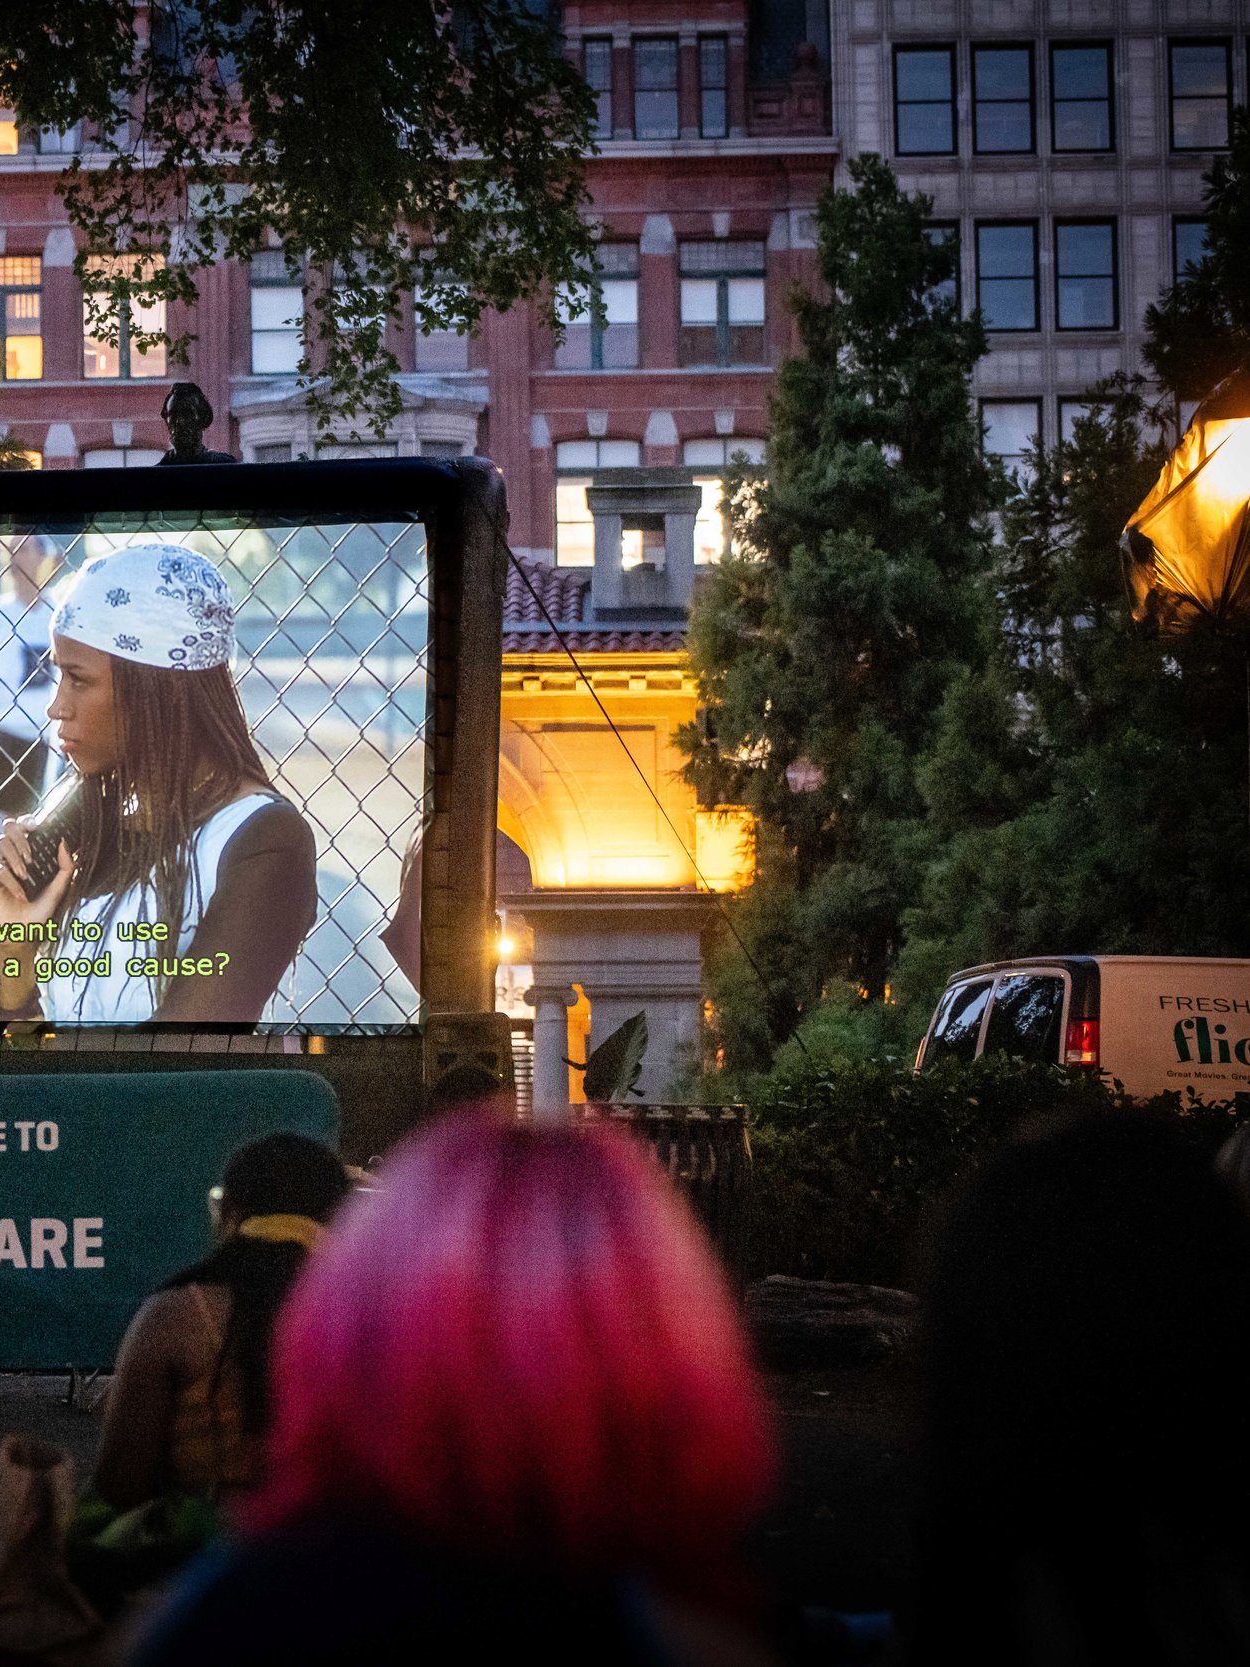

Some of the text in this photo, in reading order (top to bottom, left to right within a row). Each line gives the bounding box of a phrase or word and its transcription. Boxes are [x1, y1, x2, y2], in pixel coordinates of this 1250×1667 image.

[71, 920, 102, 942] to
[117, 922, 169, 942] use
[3, 957, 21, 977] a
[34, 952, 112, 982] good
[125, 951, 231, 977] cause?
[1158, 995, 1250, 1014] FRESH
[1166, 1070, 1192, 1079] Great
[13, 1120, 60, 1152] TO
